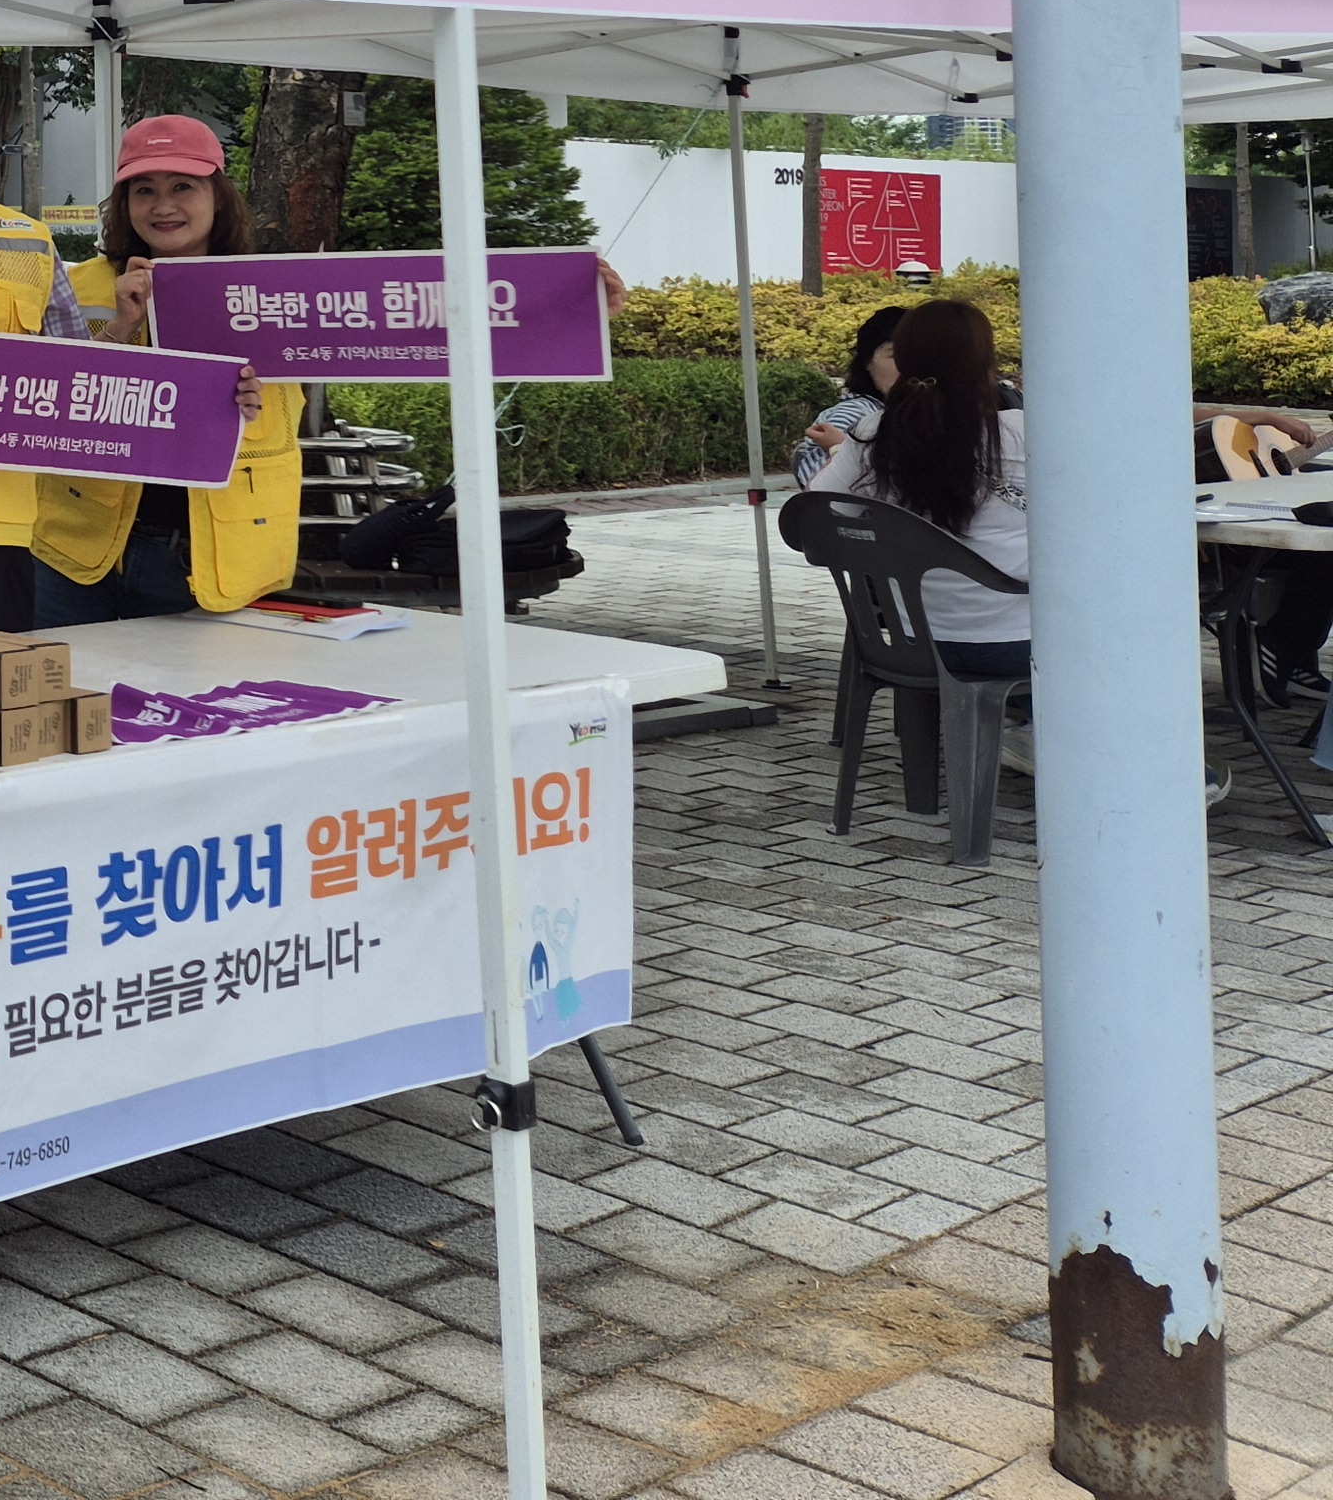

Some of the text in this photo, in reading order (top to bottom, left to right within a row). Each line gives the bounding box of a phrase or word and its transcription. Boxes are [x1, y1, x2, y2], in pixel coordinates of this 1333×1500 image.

[224, 279, 520, 332] 행복한 인생, 함께요
[281, 345, 333, 362] 송도4동
[13, 374, 59, 421] 인생,
[68, 371, 178, 430] 함께해요
[22, 432, 131, 458] 지역사회보장협의체
[95, 823, 283, 947] 찾아서
[306, 766, 591, 900] 알려주요!
[4, 980, 107, 1059] 필요한
[115, 958, 208, 1032] 분들을
